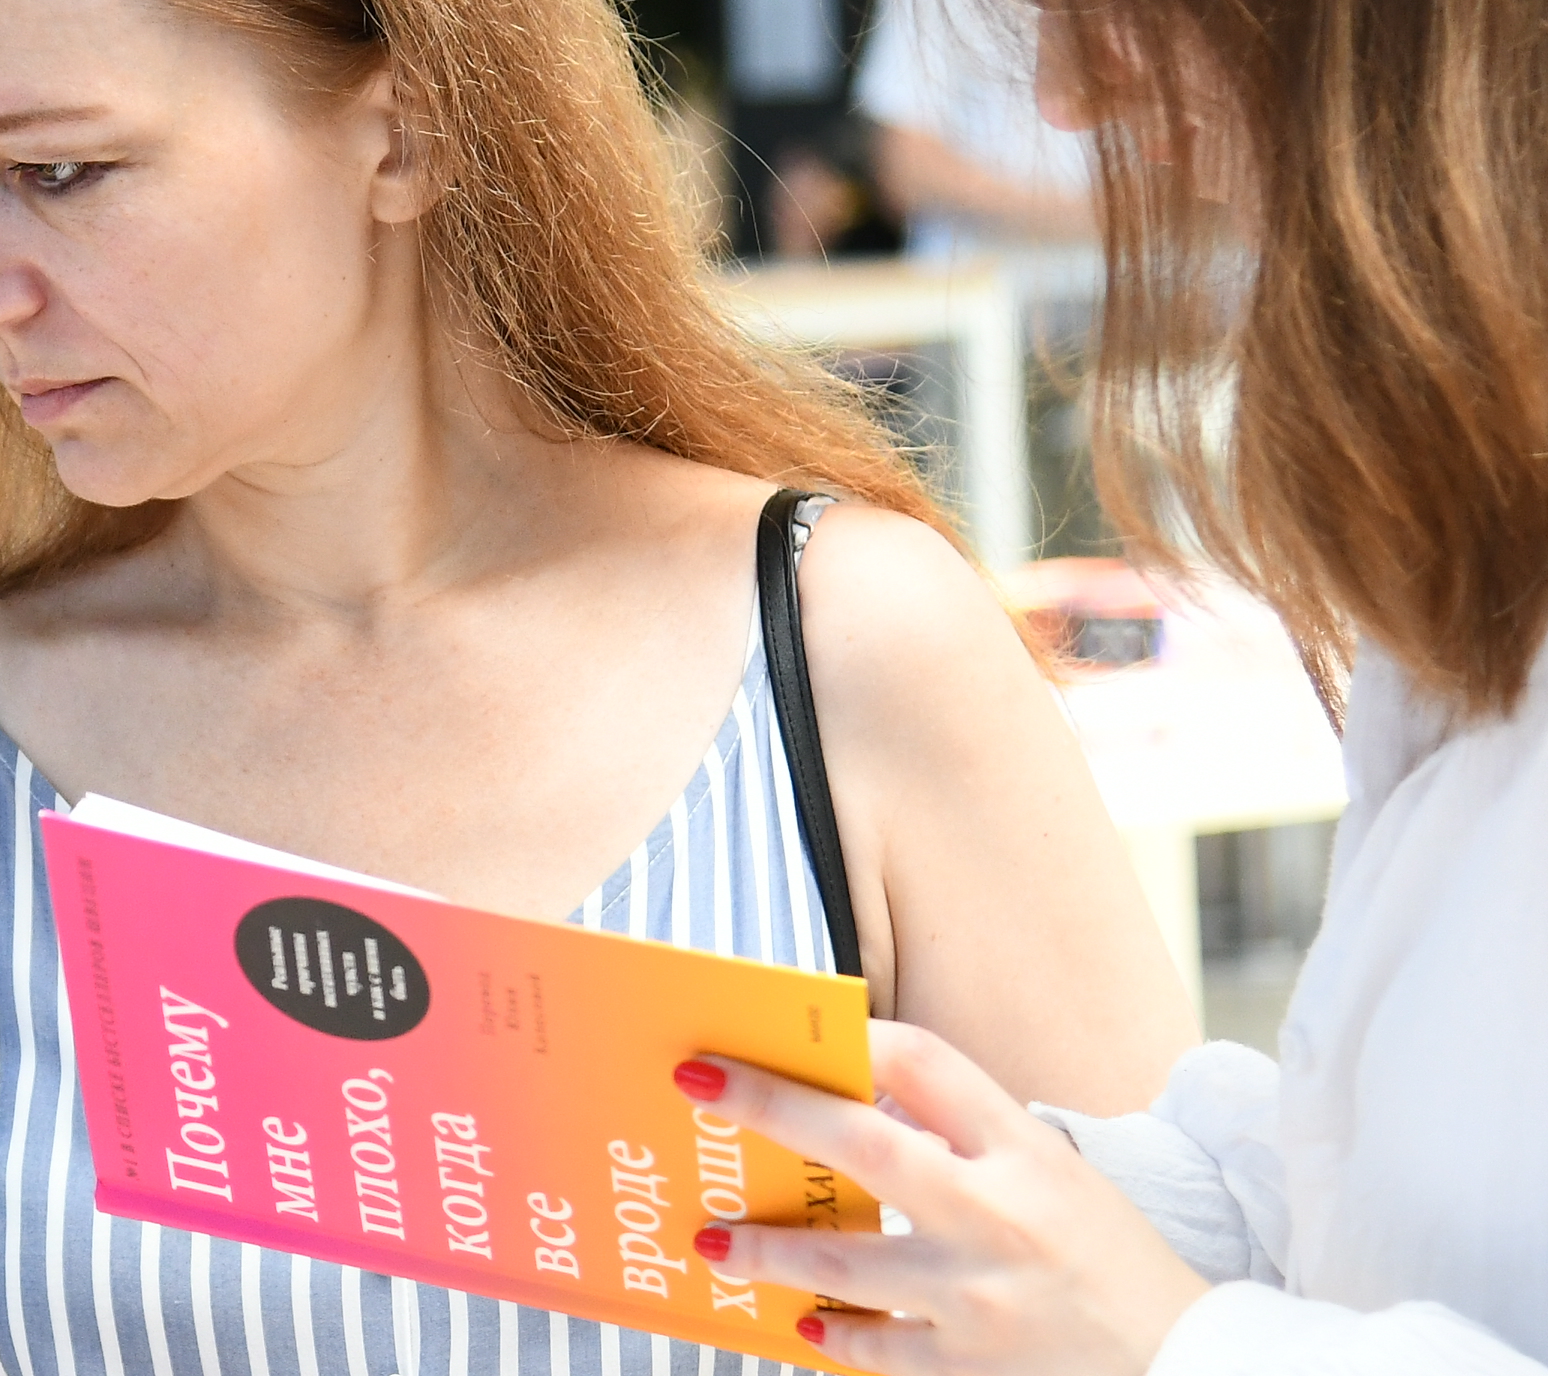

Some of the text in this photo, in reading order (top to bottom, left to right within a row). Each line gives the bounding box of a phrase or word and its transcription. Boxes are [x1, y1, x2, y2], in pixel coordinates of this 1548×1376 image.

[159, 984, 232, 1204] Почему
[266, 1114, 321, 1224] мне
[341, 1065, 408, 1243] плохо,
[429, 1110, 494, 1262] когда
[526, 1190, 581, 1282] все
[606, 1138, 688, 1301] вроде
